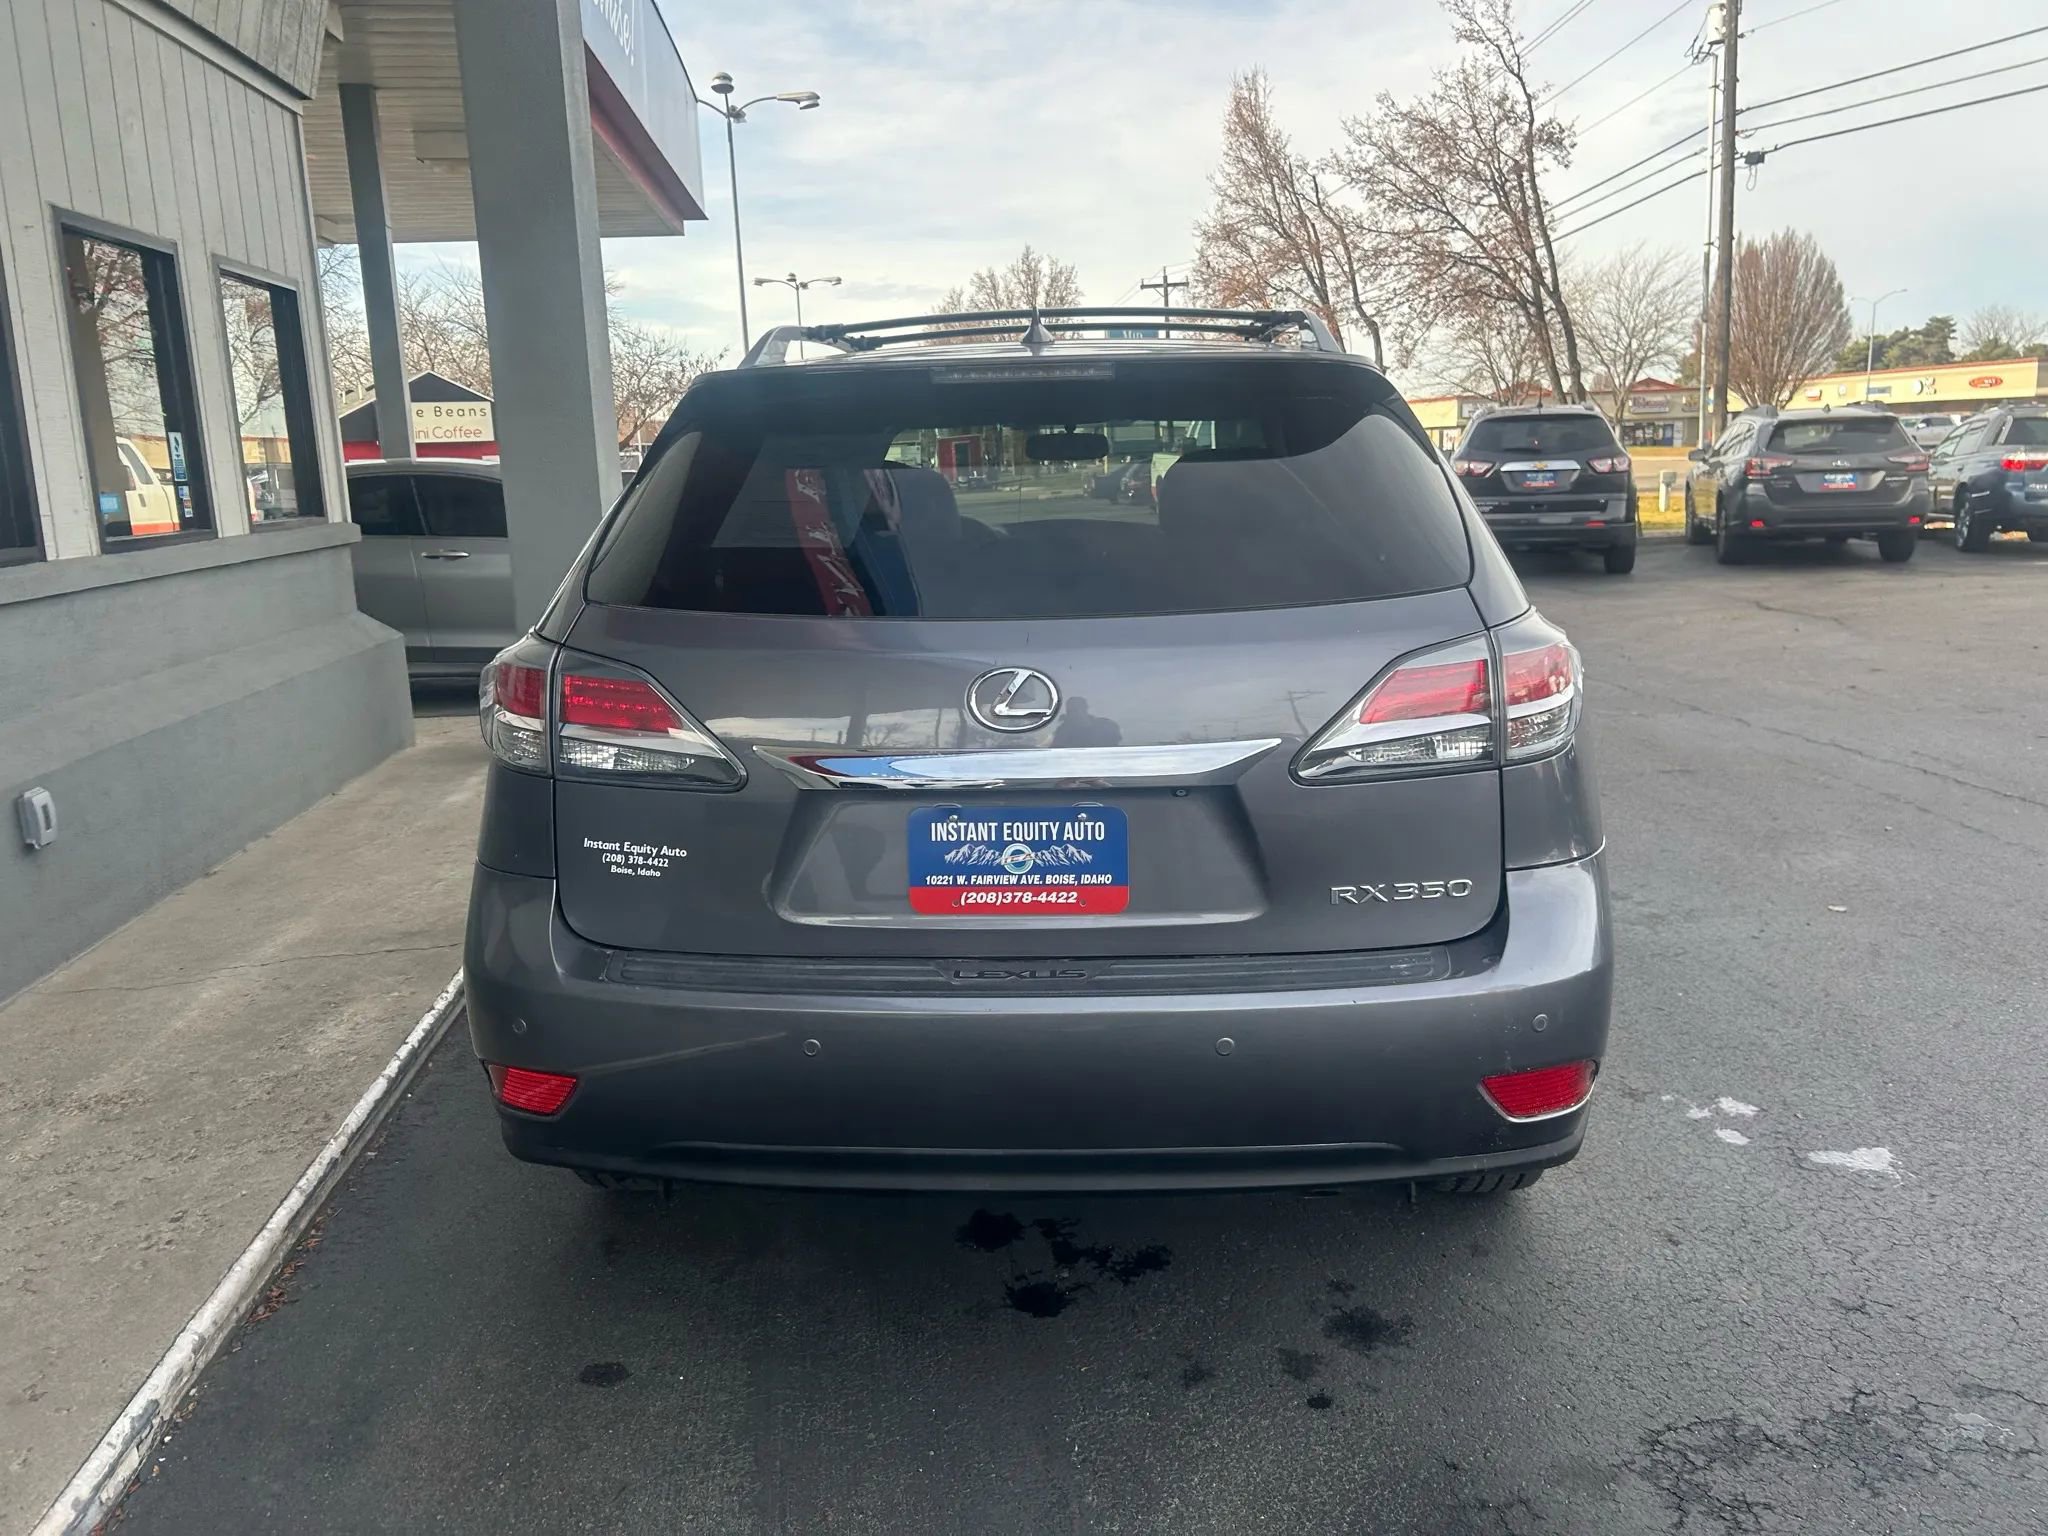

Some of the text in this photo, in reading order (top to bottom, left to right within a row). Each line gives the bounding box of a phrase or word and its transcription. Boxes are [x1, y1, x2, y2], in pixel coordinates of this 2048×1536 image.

[434, 406, 487, 417] Beans
[415, 425, 482, 439] ini Coffee
[931, 821, 1104, 841] INSTANT EQUITY AUTO
[584, 838, 687, 857] Instant Equity Auto
[602, 853, 669, 867] (208) 378-4422
[610, 865, 661, 877] Boise, Idaho
[925, 873, 1113, 887] 10221 W. FAIRVIEW AVE. BOISE, IDAHO
[960, 892, 1078, 906] (208)378-4422
[953, 968, 1087, 981] LEXUS
